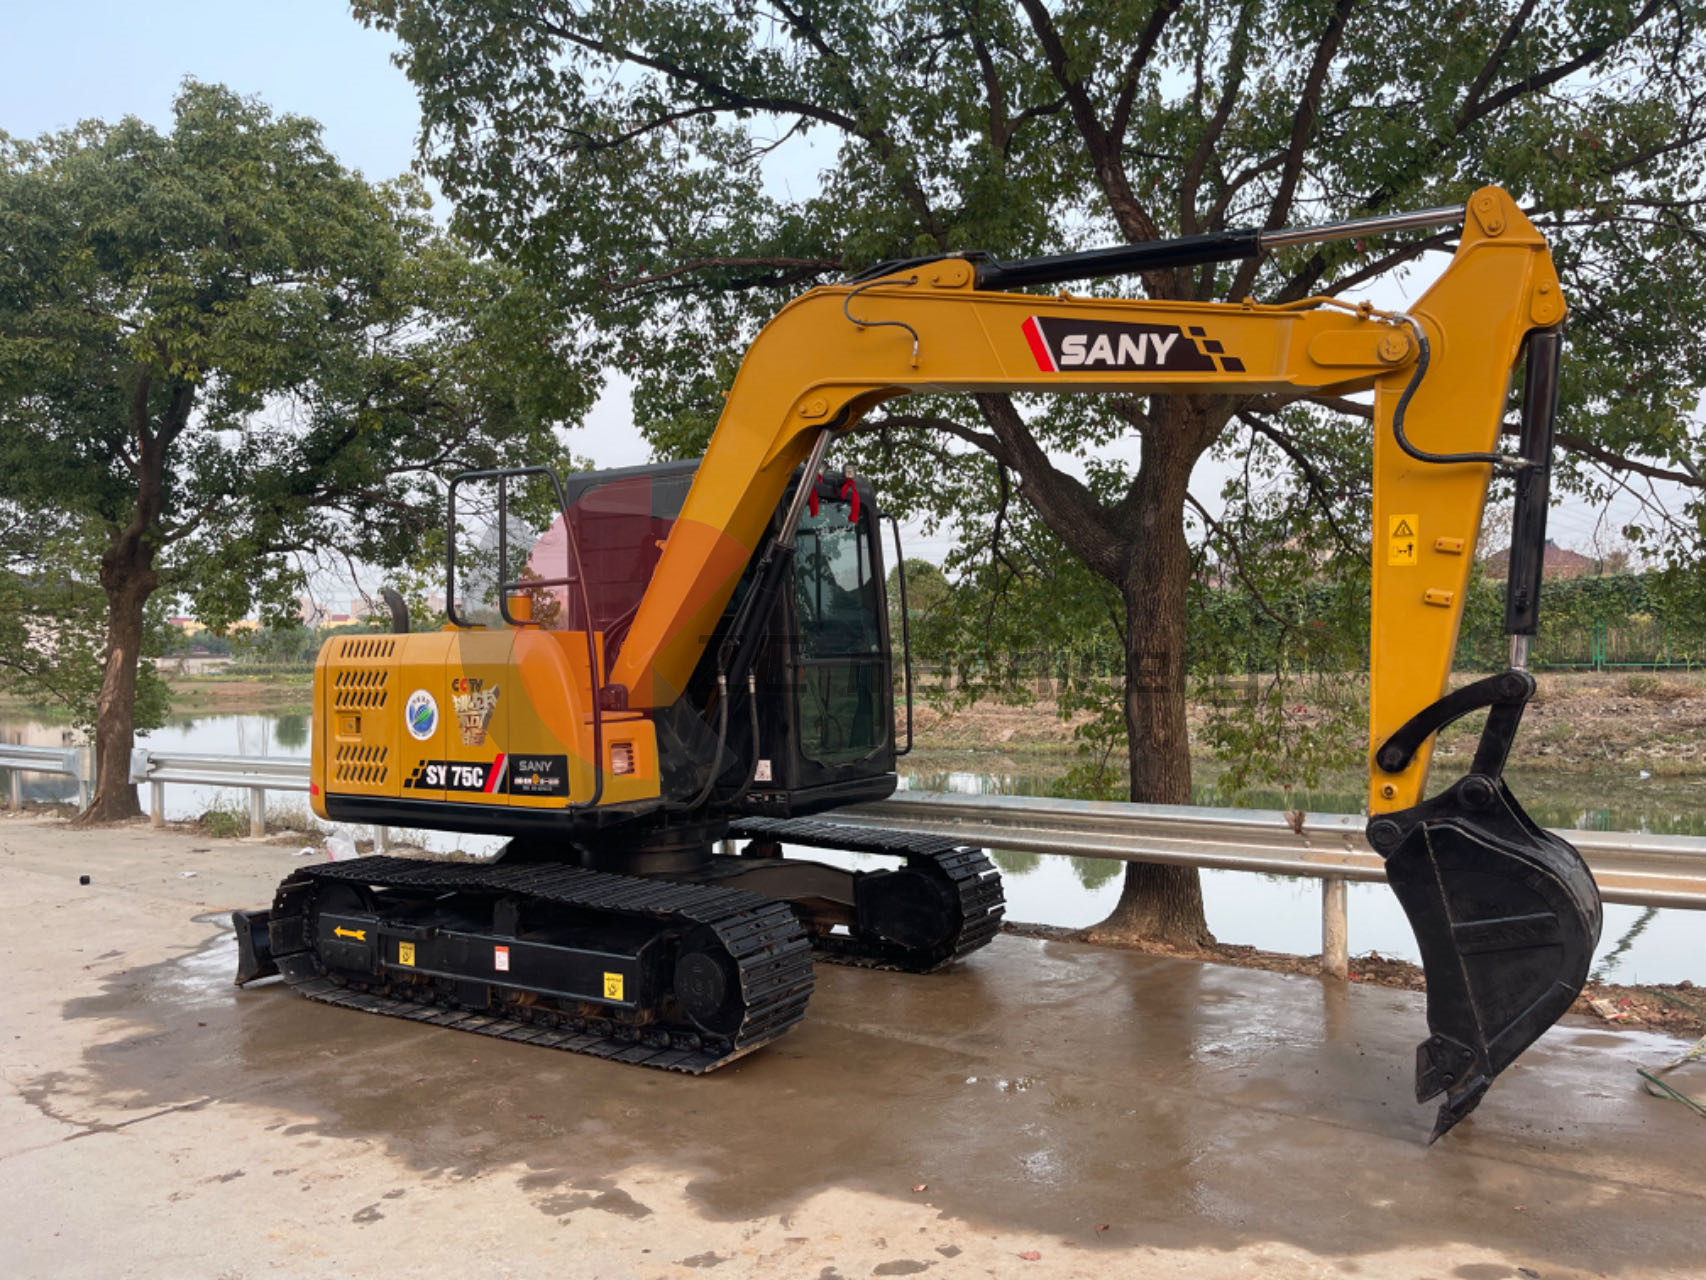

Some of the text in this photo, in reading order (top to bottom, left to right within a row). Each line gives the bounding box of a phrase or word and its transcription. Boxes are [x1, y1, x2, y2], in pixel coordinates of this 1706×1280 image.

[1060, 333, 1179, 366] SANY
[452, 678, 483, 692] CCTV
[519, 760, 552, 772] SANY
[426, 764, 484, 788] SY 75C
